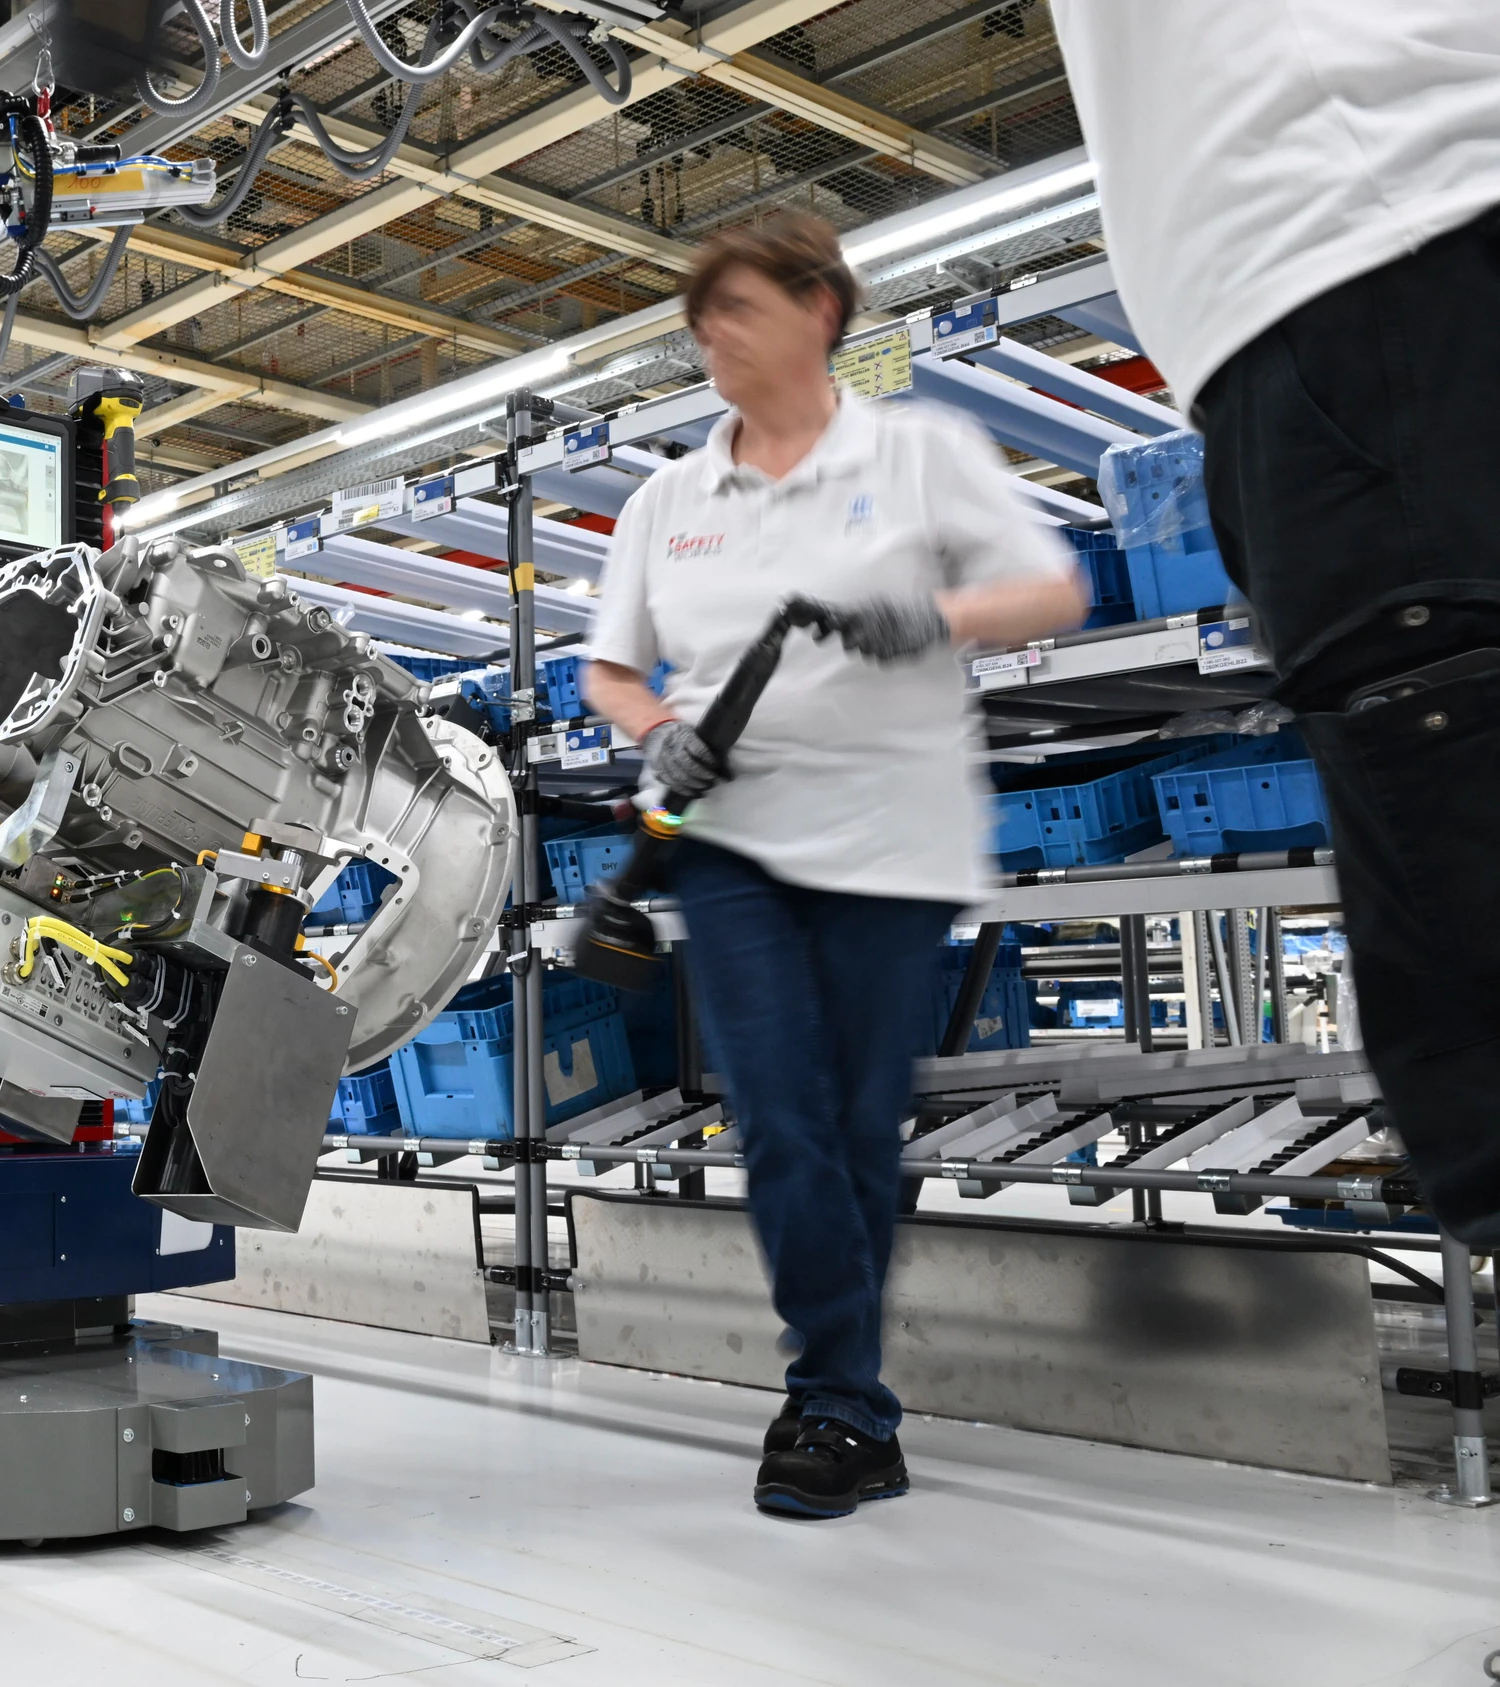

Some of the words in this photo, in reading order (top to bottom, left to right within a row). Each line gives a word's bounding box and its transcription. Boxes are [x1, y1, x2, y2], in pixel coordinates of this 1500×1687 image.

[67, 176, 102, 190] 100
[850, 367, 870, 377] BESTELLEN
[674, 532, 726, 552] SAFETY
[131, 798, 201, 845] POWERLINE
[601, 862, 618, 871] BHY
